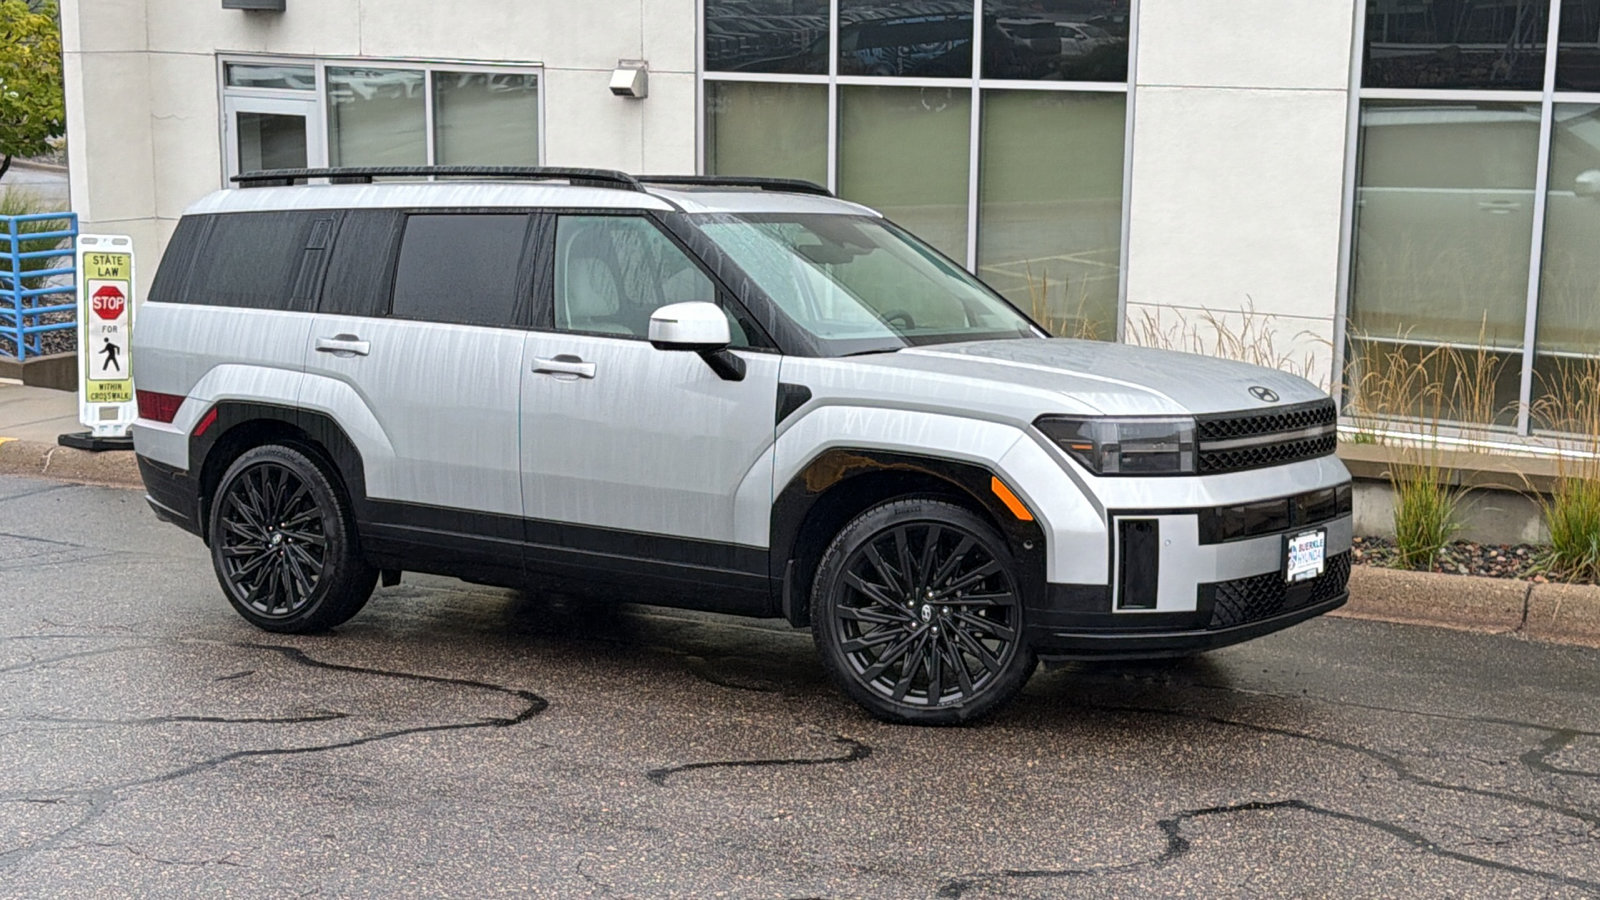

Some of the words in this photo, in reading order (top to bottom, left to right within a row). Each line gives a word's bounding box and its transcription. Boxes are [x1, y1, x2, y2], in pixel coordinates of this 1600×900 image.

[93, 255, 123, 266] STATE
[97, 267, 119, 277] LAW
[93, 296, 125, 310] STOP
[101, 325, 118, 334] FOR
[98, 383, 122, 391] WITHIN
